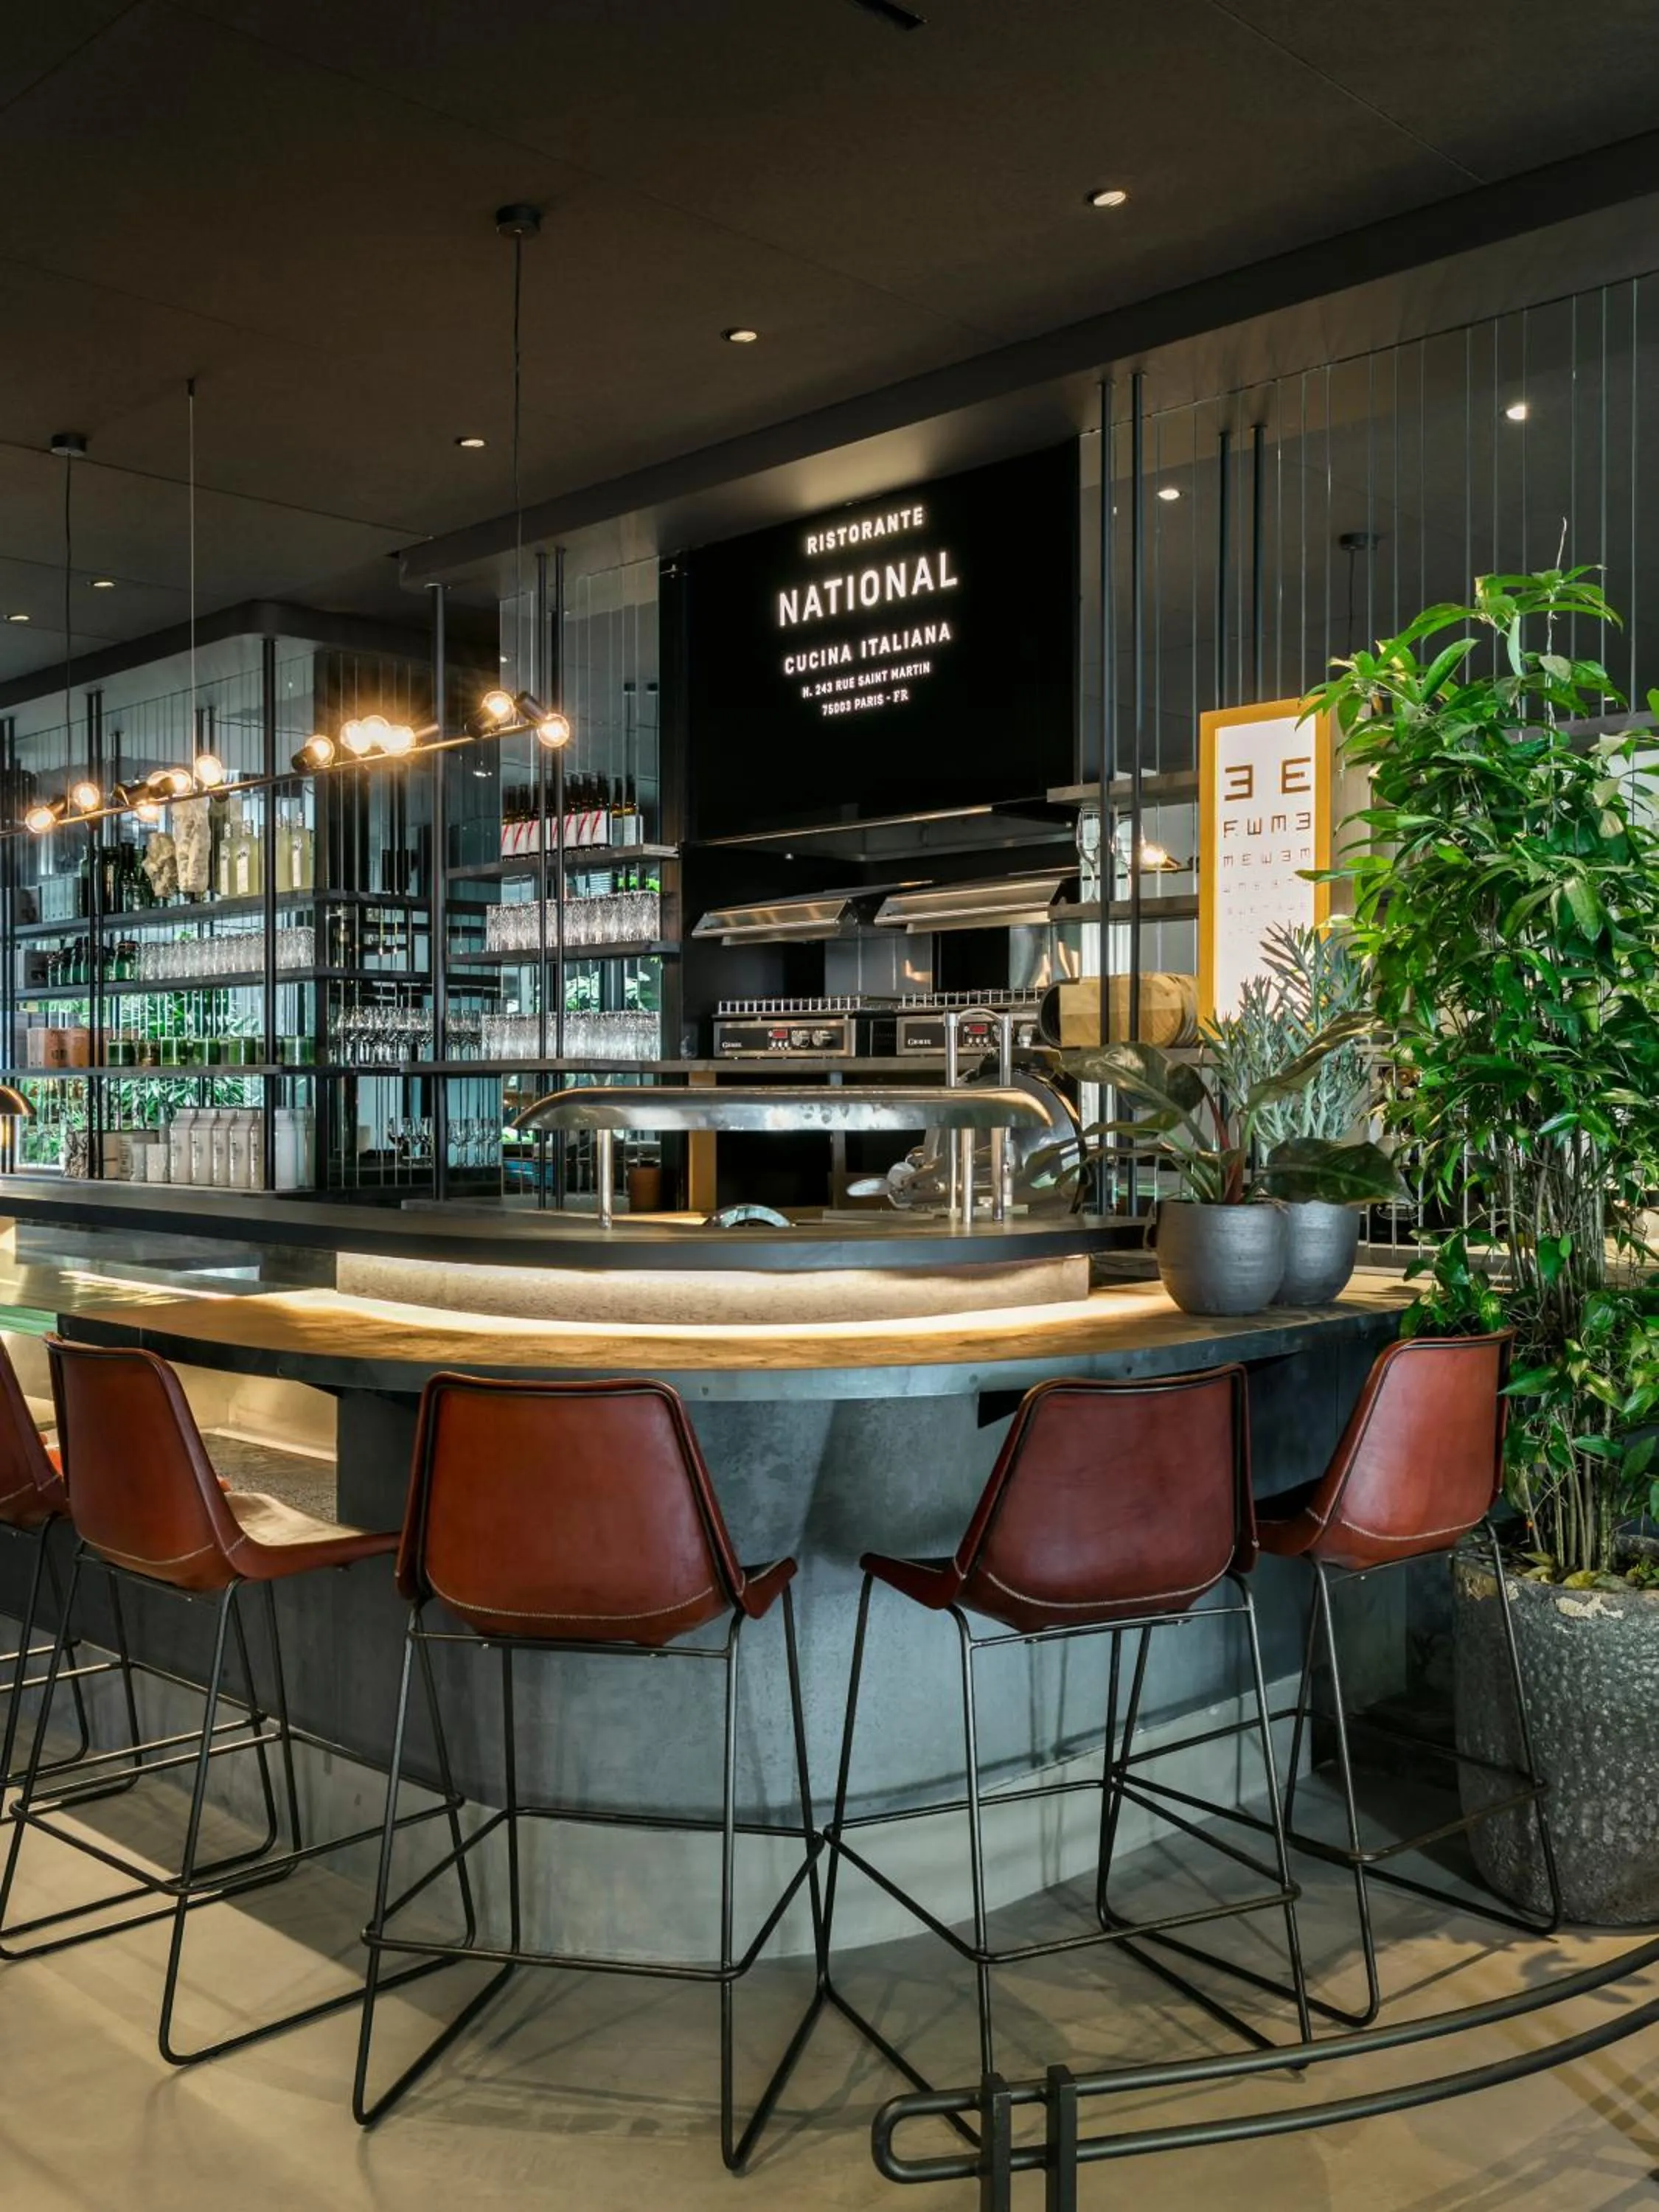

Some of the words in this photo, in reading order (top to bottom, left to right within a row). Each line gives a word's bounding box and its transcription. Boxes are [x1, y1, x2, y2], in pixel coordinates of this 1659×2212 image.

[807, 506, 924, 555] RISTORANTE
[778, 552, 958, 627] NATIONAL
[784, 644, 852, 675] CUCINA
[860, 622, 952, 658] ITALIANA
[815, 681, 833, 696] 243
[835, 676, 855, 692] RUE
[858, 669, 888, 687] SAINT
[890, 661, 931, 681] MARTIN
[822, 700, 852, 716] 75003
[855, 693, 883, 711] PARIS
[893, 689, 908, 703] FR
